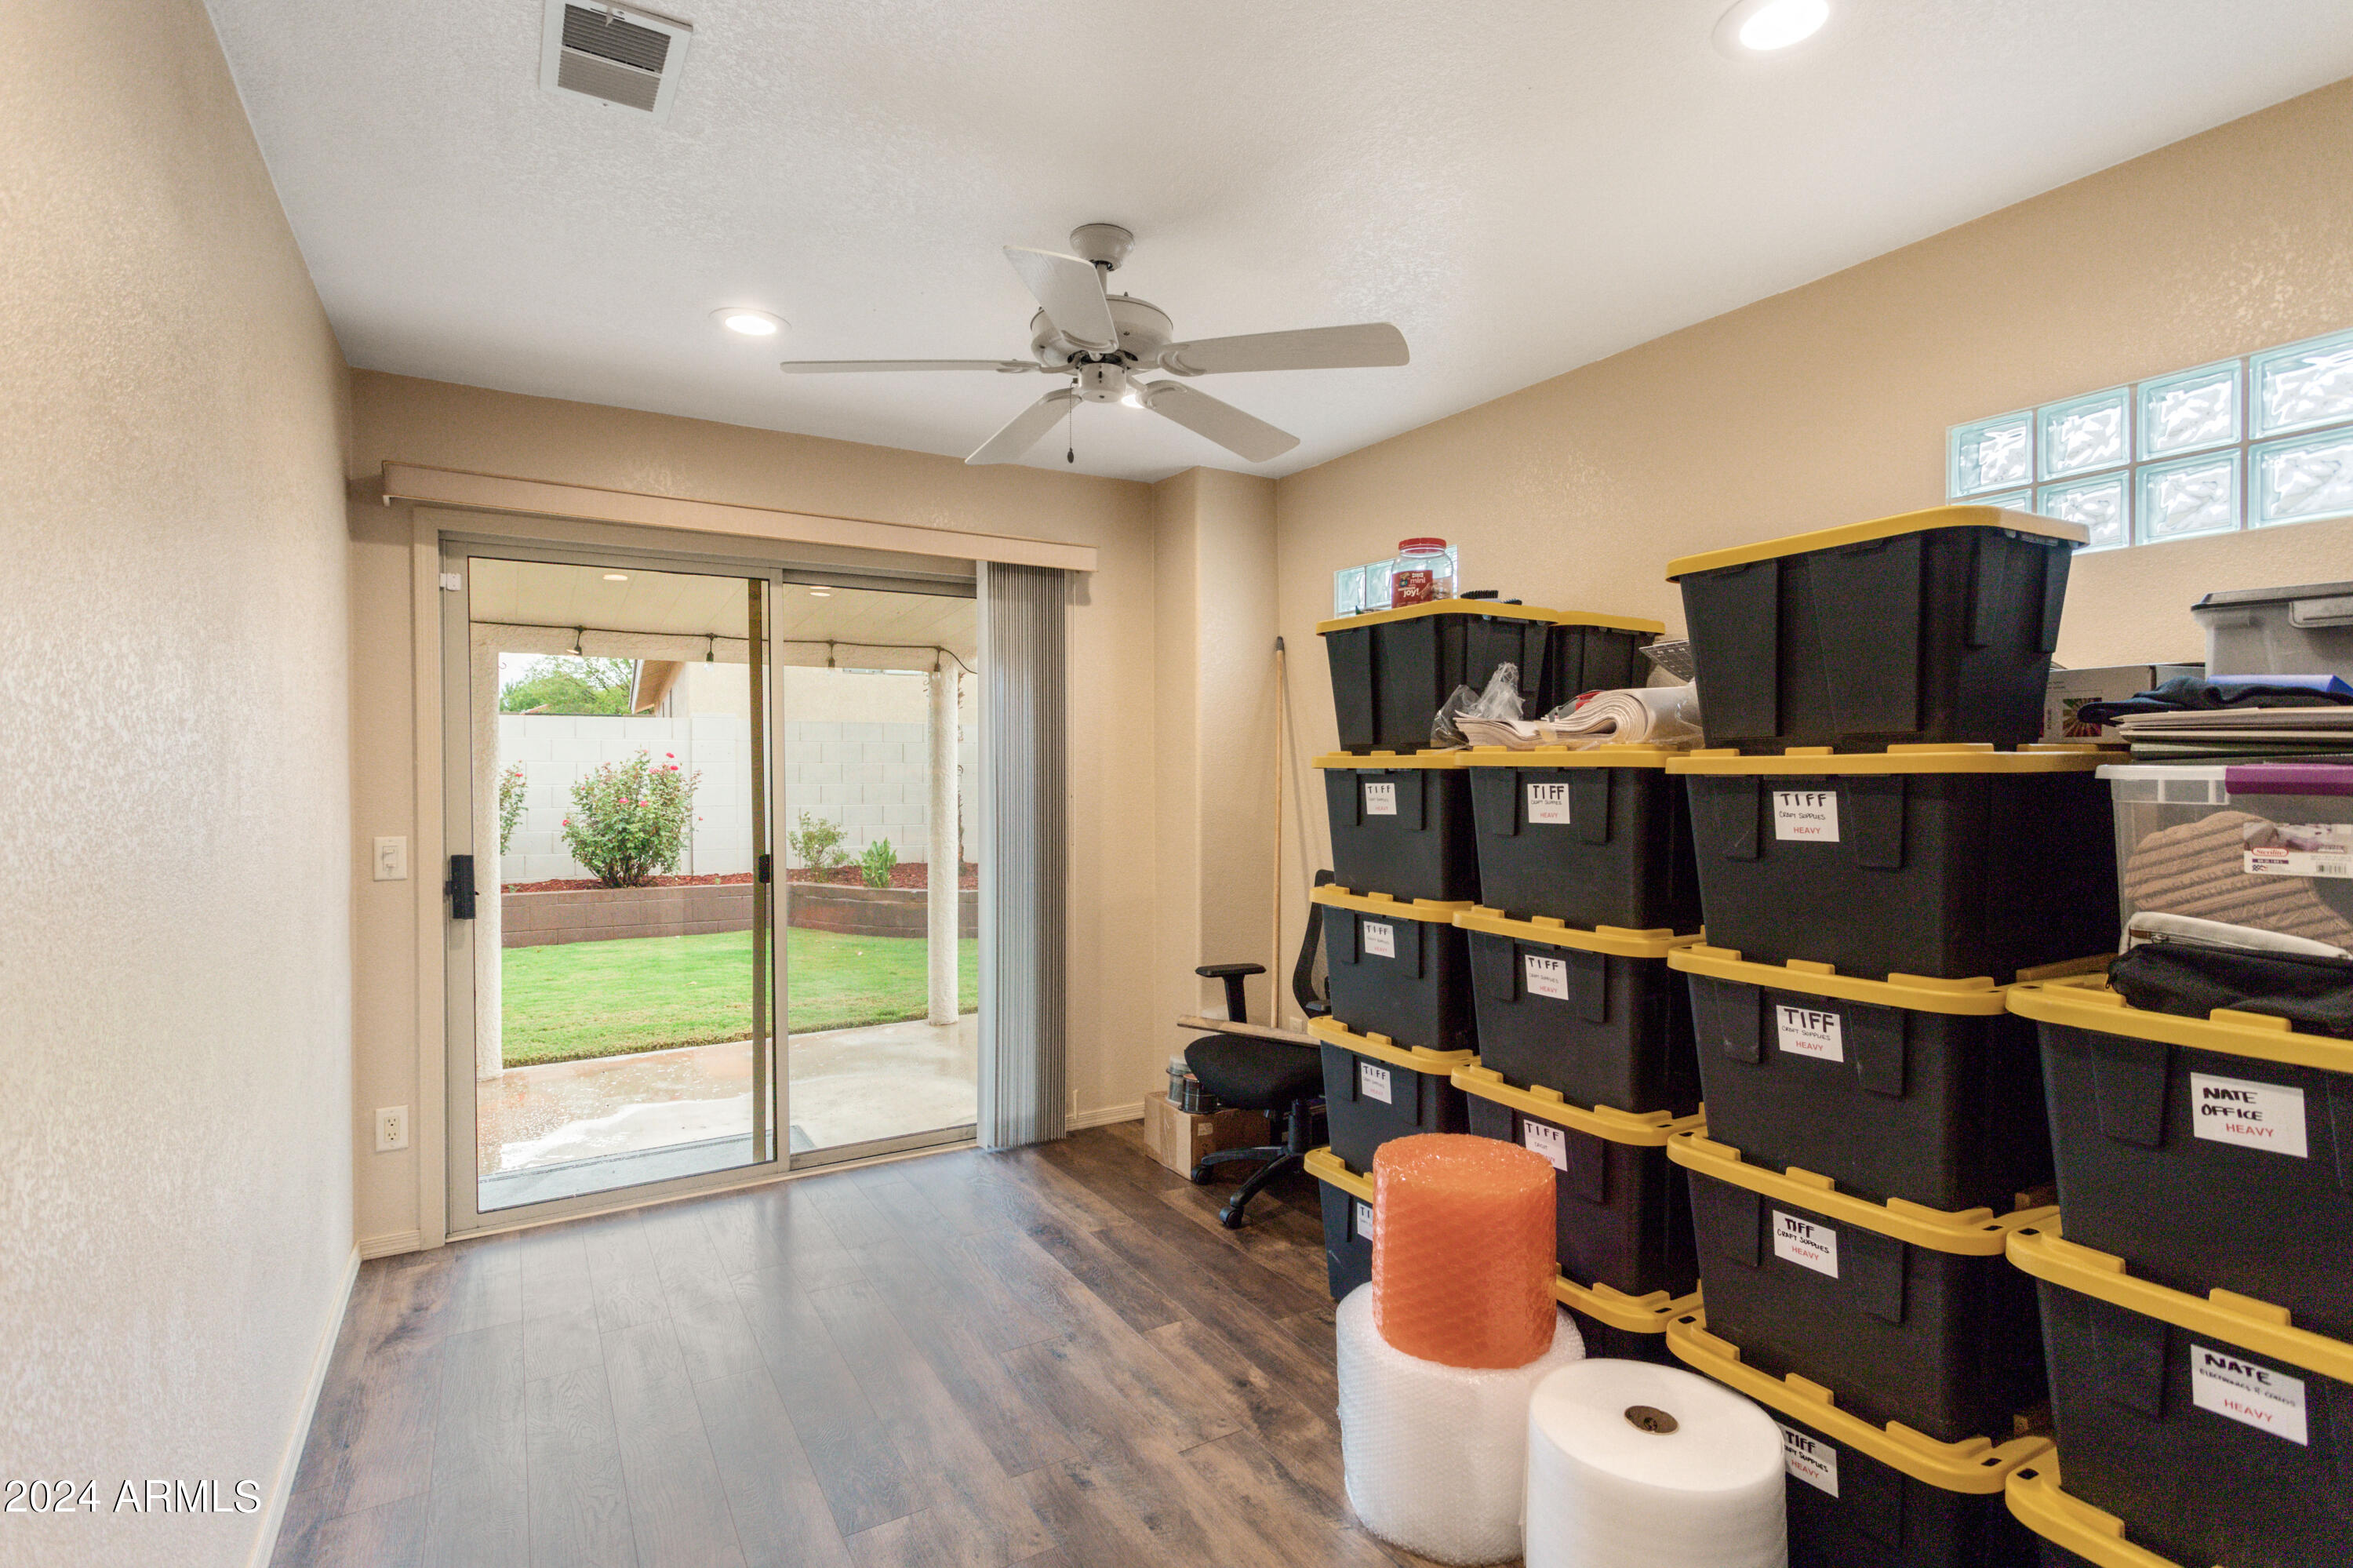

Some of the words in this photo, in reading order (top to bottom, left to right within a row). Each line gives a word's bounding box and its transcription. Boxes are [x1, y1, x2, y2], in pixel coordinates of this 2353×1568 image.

[1403, 588, 1420, 598] joy!
[1368, 785, 1391, 794] TIFF
[1533, 785, 1565, 800] TIFF
[1780, 793, 1827, 807] TIFF
[1798, 812, 1826, 820] SUPPLIES
[1366, 926, 1387, 935] TIFF
[1528, 957, 1558, 970] TIFF
[1784, 1008, 1835, 1033] TIFF
[1782, 1025, 1798, 1034] CRAFT
[1802, 1030, 1831, 1041] SUPPLIES
[1795, 1040, 1824, 1051] HEAVY
[1363, 1065, 1386, 1080] TIFF
[2202, 1087, 2257, 1104] NATE
[2201, 1104, 2263, 1121] OFFICE
[1526, 1122, 1559, 1141] TIFF
[2226, 1123, 2274, 1137] HEAVY
[1784, 1217, 1814, 1239] TIFF
[1777, 1228, 1797, 1241] CRAFT
[1799, 1236, 1830, 1253] SUPPLIES
[1792, 1246, 1819, 1261] HEAVY
[2205, 1354, 2271, 1385] NATE
[2224, 1399, 2272, 1422] HEAVY
[1785, 1430, 1816, 1453] TIFF
[1791, 1459, 1820, 1478] HEAVY
[1798, 1451, 1828, 1472] SUPPLIES
